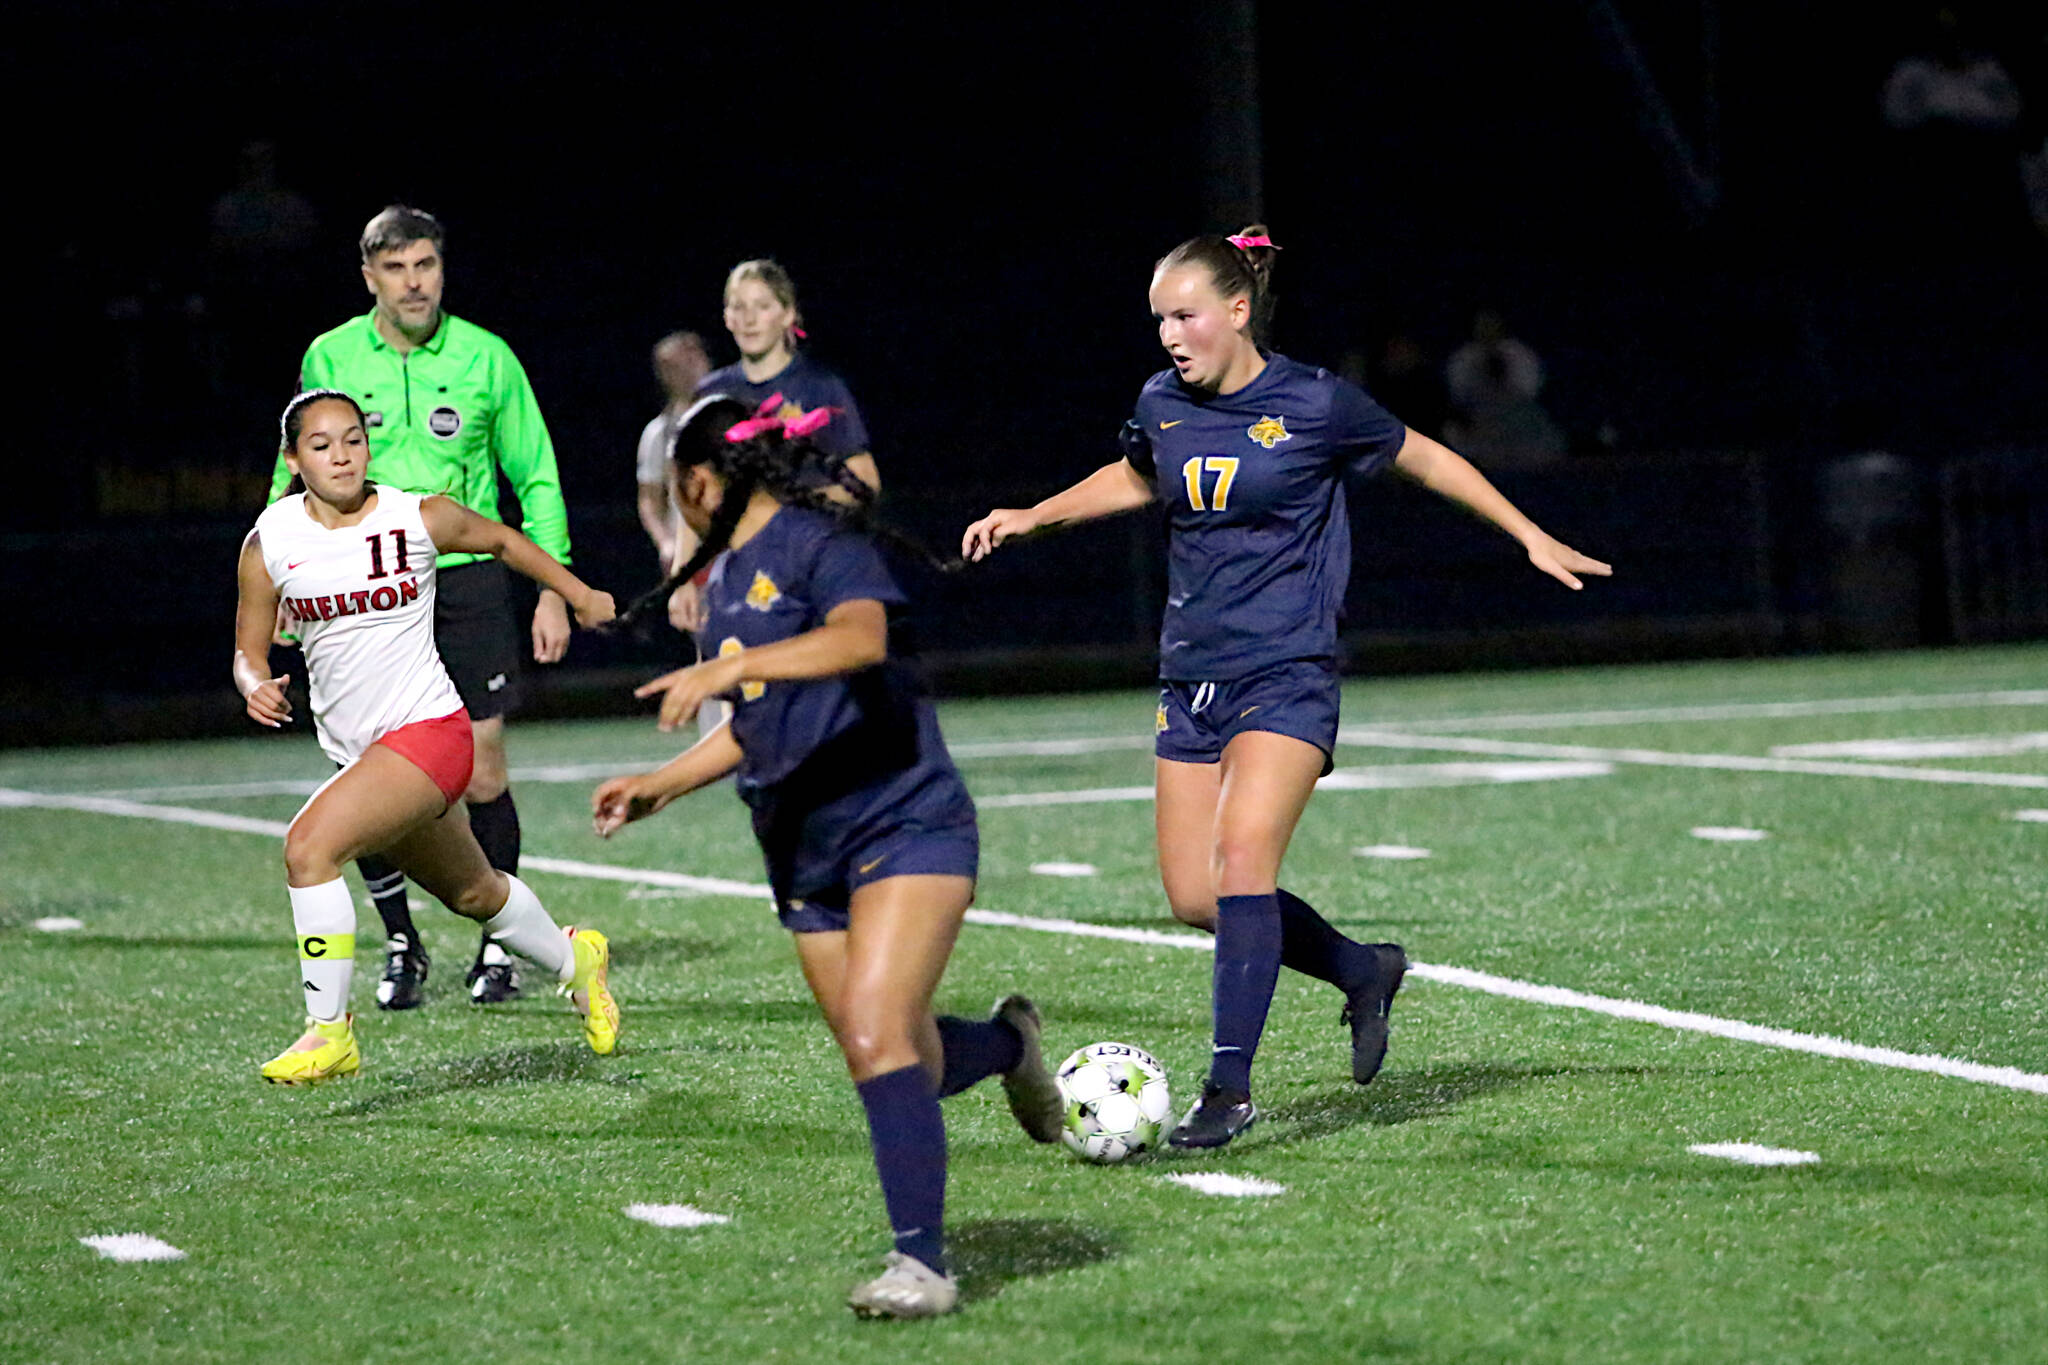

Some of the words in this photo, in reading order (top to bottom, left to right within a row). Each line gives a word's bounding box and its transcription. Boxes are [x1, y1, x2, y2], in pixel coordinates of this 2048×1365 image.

[1183, 456, 1239, 511] 17
[366, 529, 412, 580] 11
[285, 576, 419, 622] SHELTON
[304, 937, 327, 958] C
[1097, 1045, 1161, 1072] SELECT
